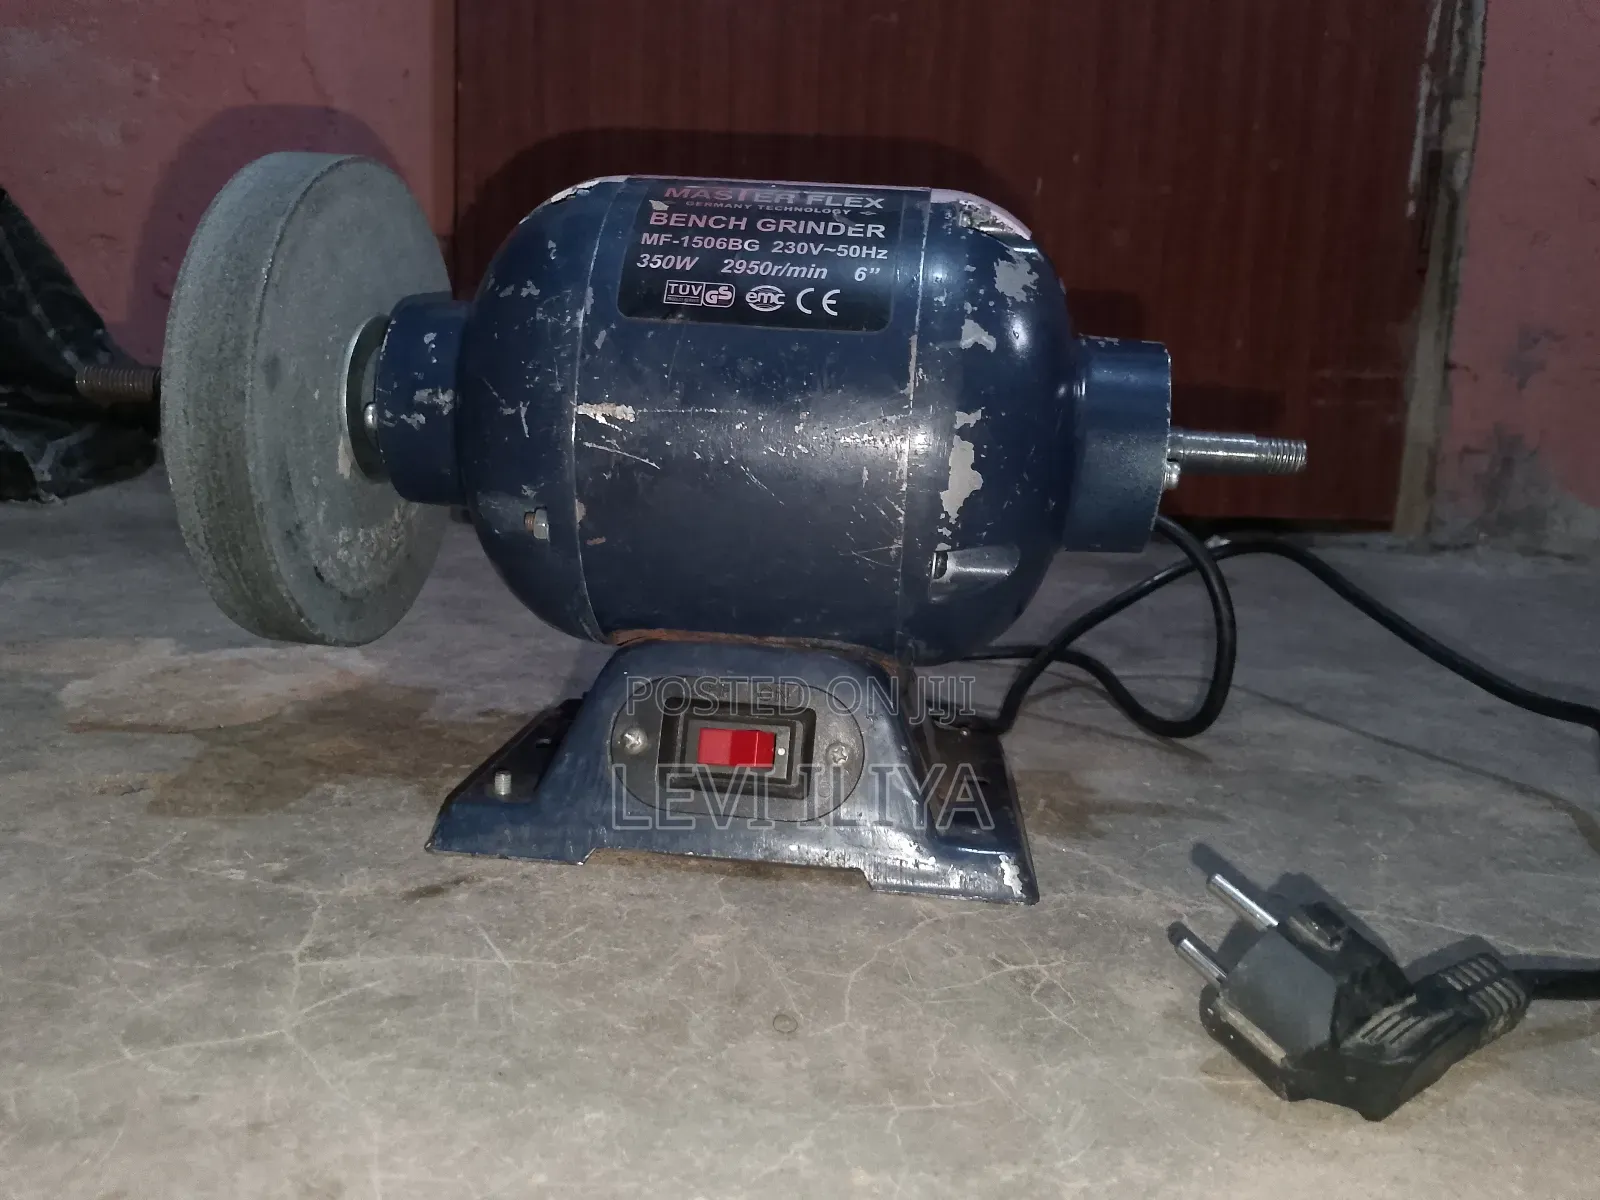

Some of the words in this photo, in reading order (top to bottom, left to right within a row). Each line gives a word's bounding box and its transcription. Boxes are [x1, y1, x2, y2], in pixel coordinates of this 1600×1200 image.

[664, 187, 795, 205] MASTER
[806, 193, 885, 209] FLEX
[685, 200, 752, 210] GERMANY
[757, 204, 851, 215] TECHNOLOGY
[649, 211, 747, 231] BENCH
[756, 217, 886, 238] GRINDER
[640, 232, 760, 252] MF-1506BG
[636, 253, 699, 271] 350W
[720, 258, 828, 280] 2950r/min
[705, 286, 733, 304] GS
[796, 287, 841, 316] CE
